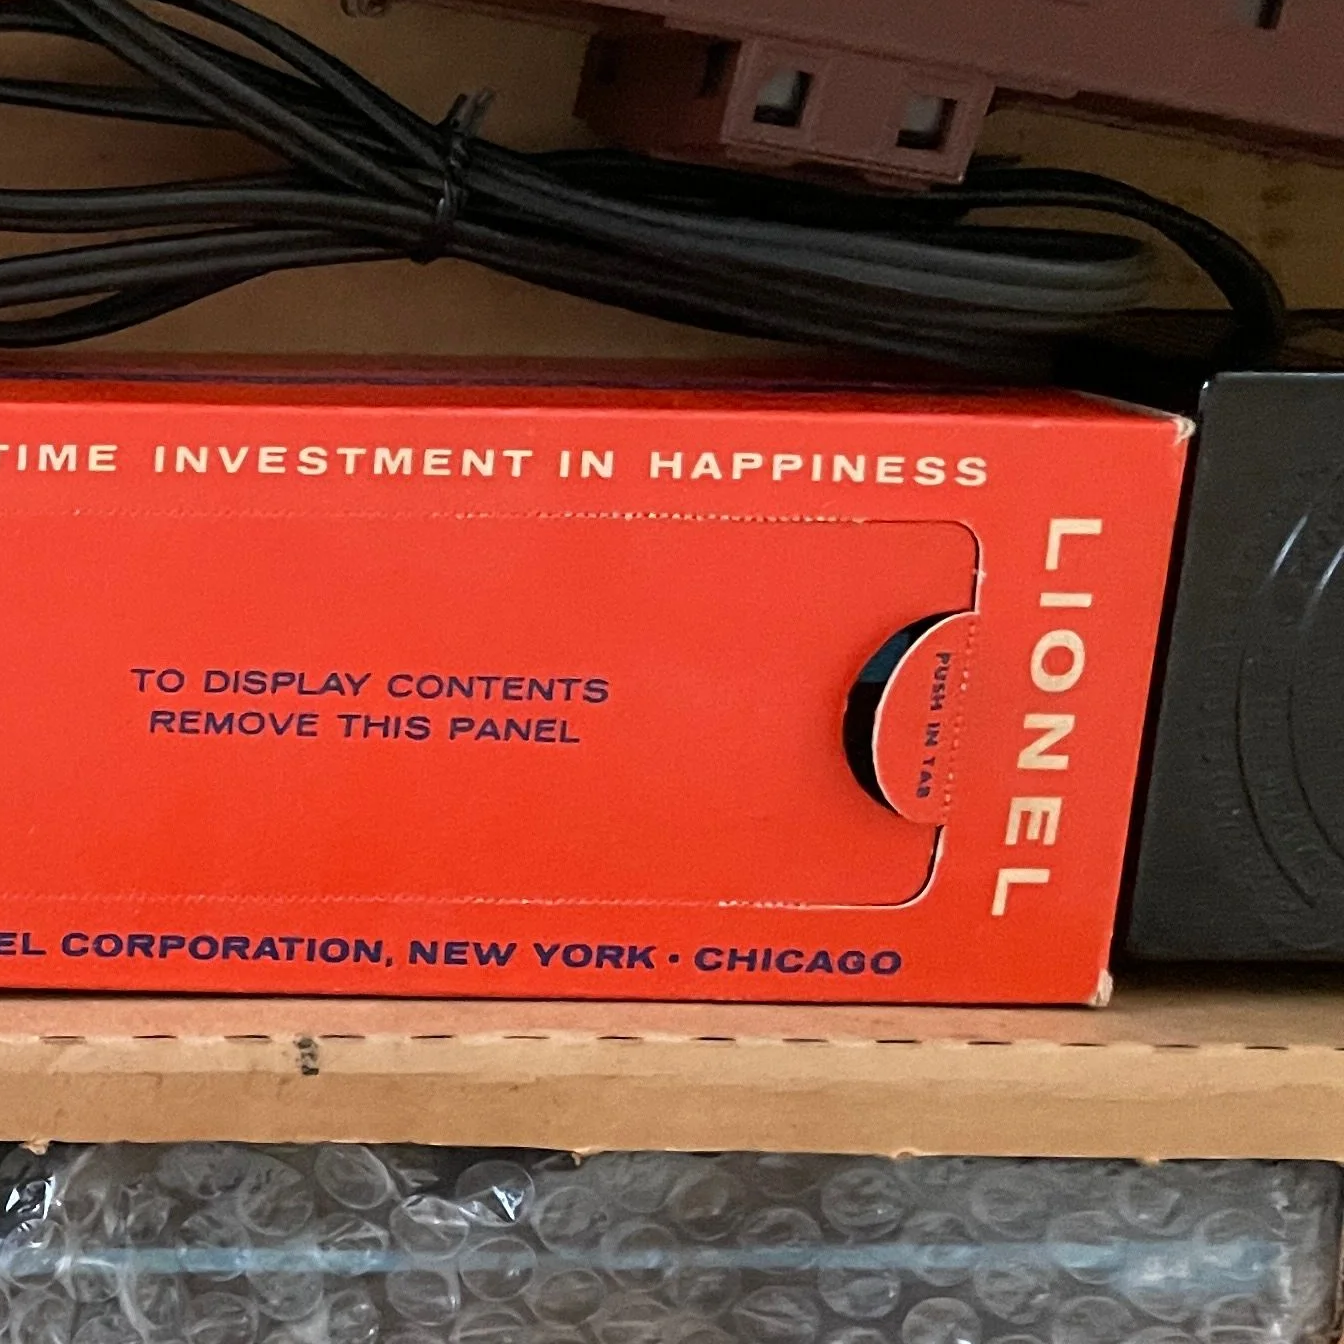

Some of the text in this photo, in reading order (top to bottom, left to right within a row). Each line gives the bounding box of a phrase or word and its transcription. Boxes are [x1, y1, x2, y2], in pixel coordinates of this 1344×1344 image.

[154, 445, 533, 478] INVESTMENT
[559, 450, 614, 478] IN
[650, 451, 987, 487] HAPPINESS
[130, 668, 609, 704] TO DISPLAY CONTENTS
[929, 651, 952, 712] PUSH
[149, 710, 580, 744] REMOVE THIS PANEL
[924, 722, 941, 747] IN
[991, 517, 1103, 916] LIONEL
[408, 940, 518, 967] NEW
[533, 942, 657, 970] YORK
[694, 947, 902, 976] CHICAGO
